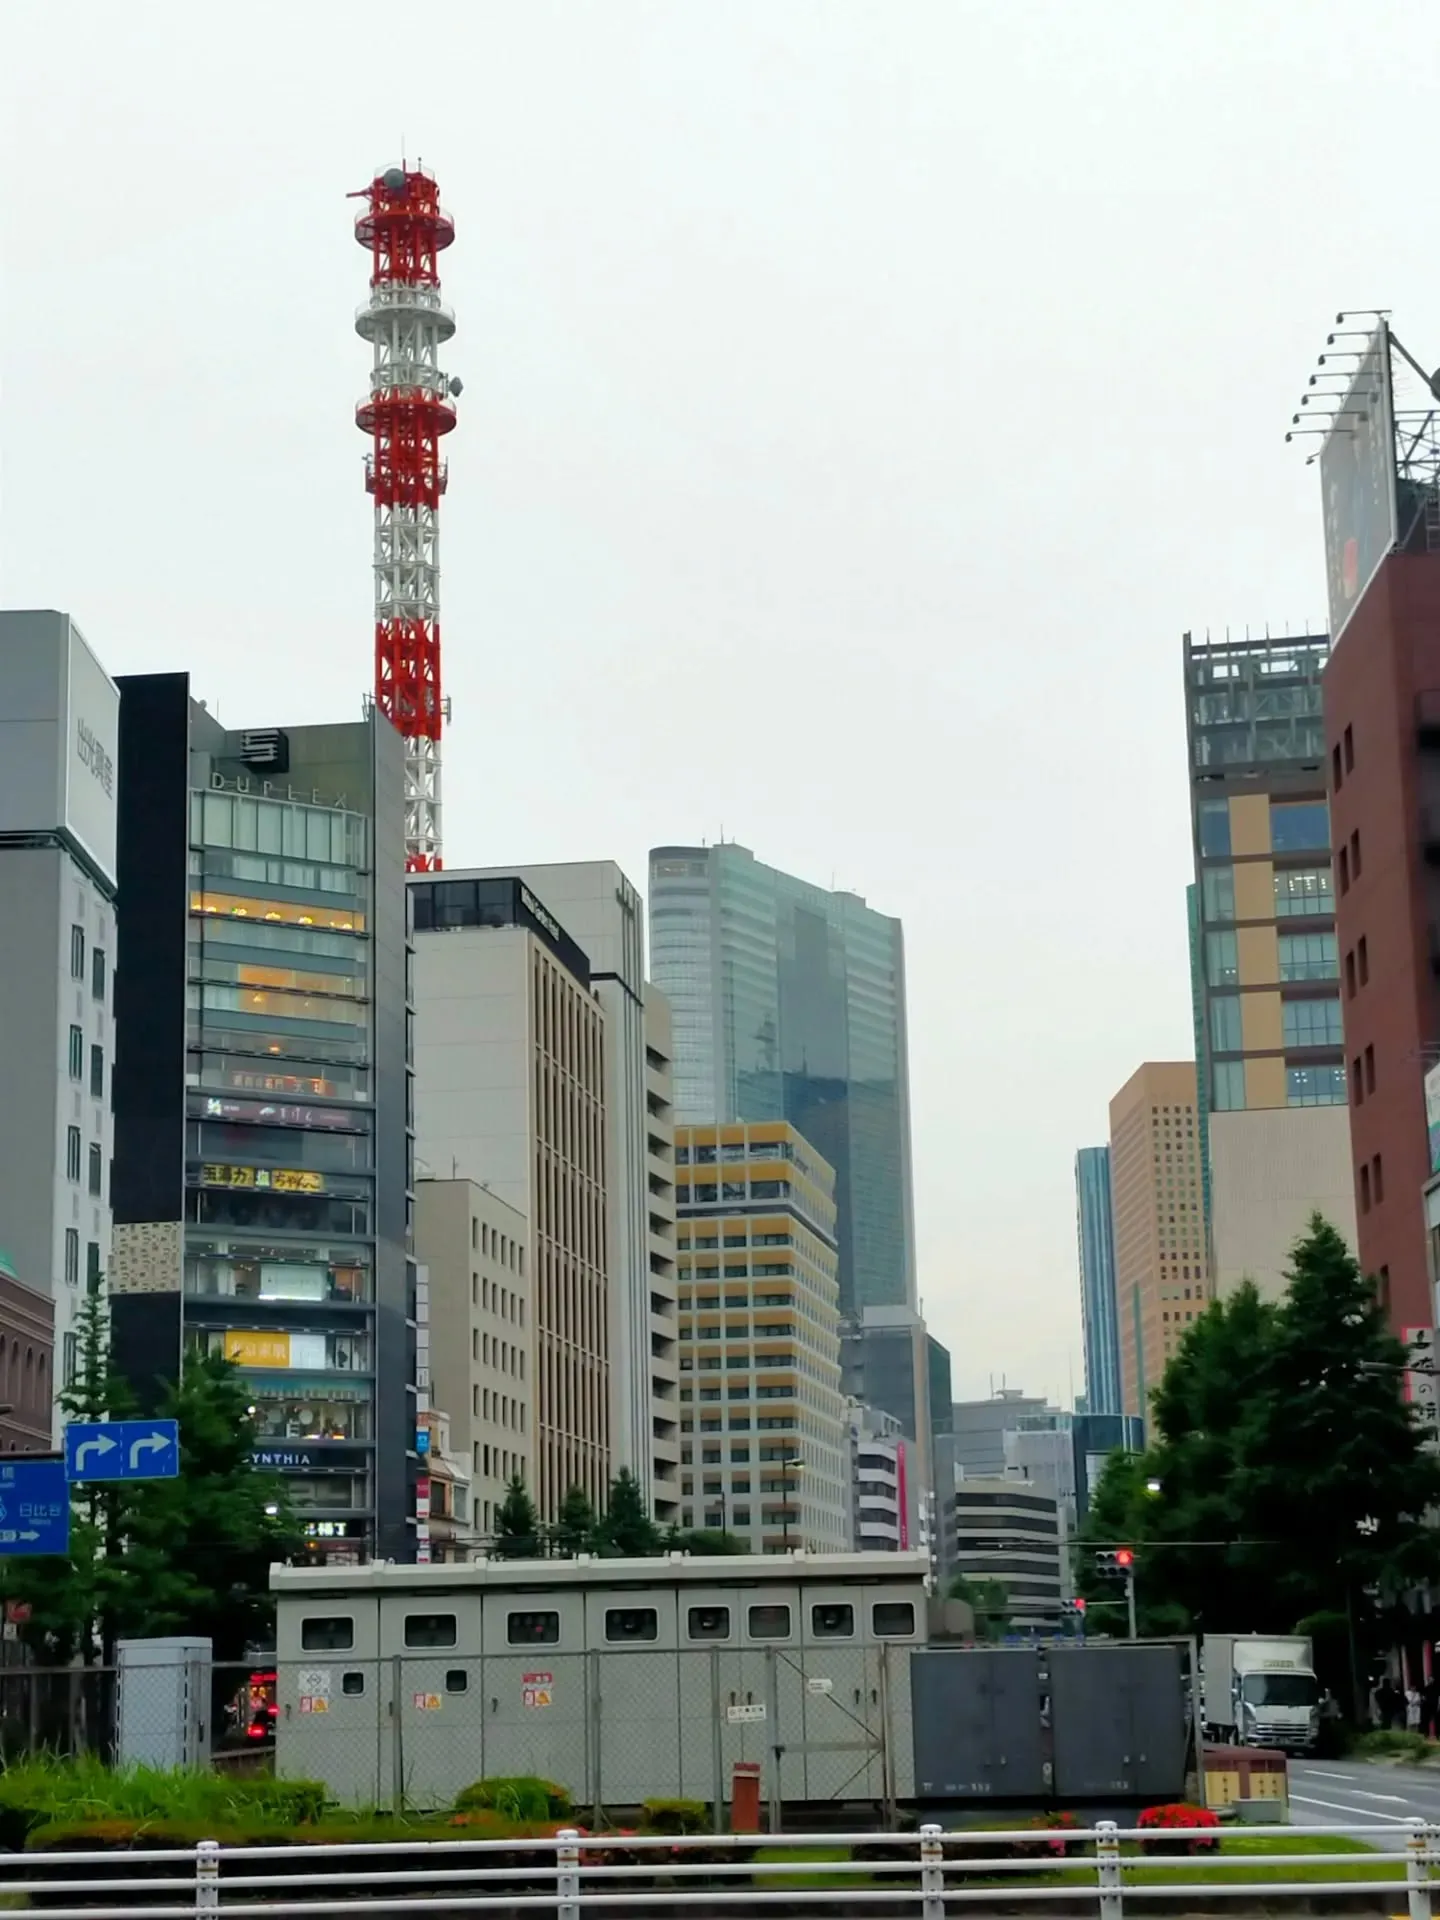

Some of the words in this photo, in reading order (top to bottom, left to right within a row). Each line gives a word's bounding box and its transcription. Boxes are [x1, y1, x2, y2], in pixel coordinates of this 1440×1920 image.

[212, 772, 347, 808] DUPLEX
[242, 1453, 310, 1465] YNTHIA
[20, 1502, 61, 1517] 日比谷
